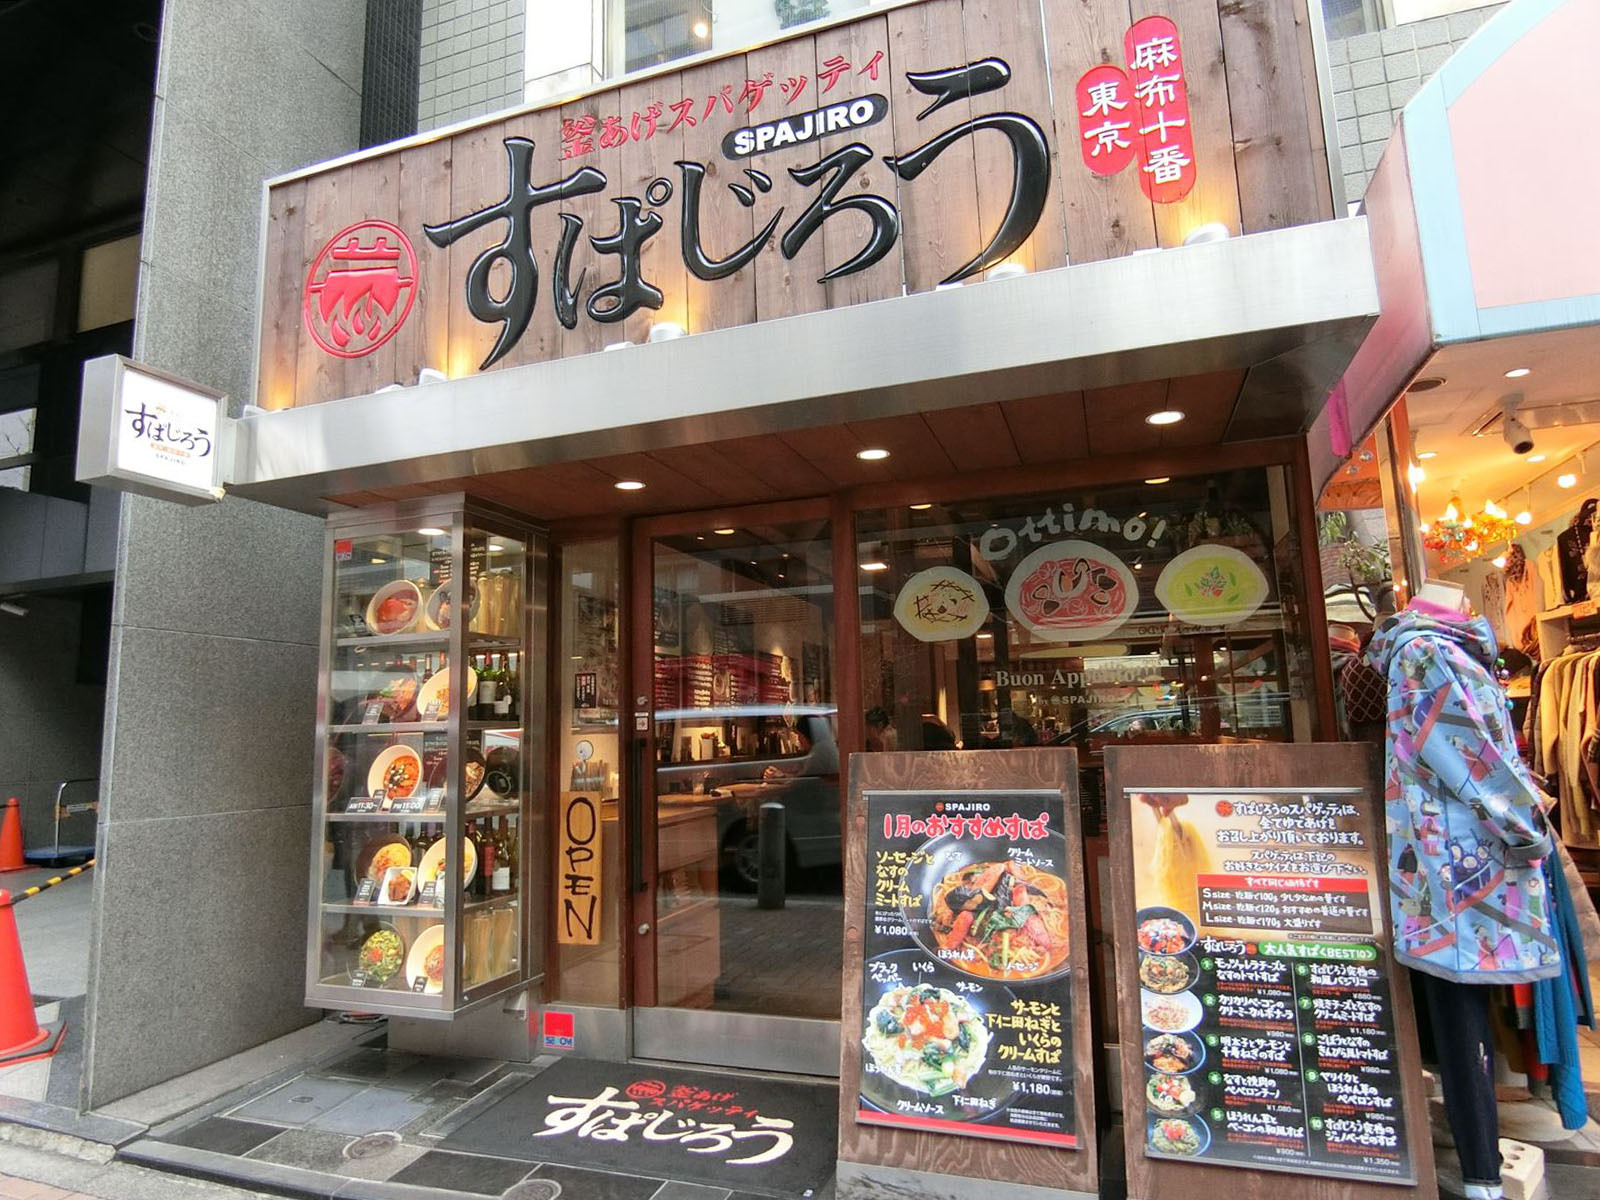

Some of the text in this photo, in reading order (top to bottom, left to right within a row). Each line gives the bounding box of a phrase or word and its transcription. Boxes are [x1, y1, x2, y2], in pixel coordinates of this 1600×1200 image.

[561, 49, 886, 160] 釜あげスパゲッティ
[1129, 36, 1191, 185] 麻布十番
[1082, 80, 1133, 157] 東京
[733, 99, 875, 156] SPAJIRO
[422, 56, 1053, 372] すぱじろう
[124, 402, 211, 457] すぱじろう
[996, 671, 1045, 687] Buon
[945, 803, 991, 811] SPAJIRO
[883, 812, 1050, 840] 1月のおすすめすぱ
[1259, 815, 1337, 830] 全てゆであげを
[1217, 830, 1364, 846] お召し上がり頂いております。
[876, 850, 934, 865] ソーセージと
[1007, 848, 1034, 857] クリーム
[564, 797, 597, 940] OPEN
[876, 865, 909, 878] なすの
[876, 879, 910, 893] クリーム
[875, 893, 923, 908] ミートすぱ
[874, 925, 908, 936] ¥1,080
[868, 961, 898, 973] ブラック
[912, 962, 935, 973] いくら
[871, 973, 903, 982] ペッパー
[955, 981, 984, 992] サーモン
[1010, 999, 1062, 1016] サーモンと
[986, 1013, 1062, 1032] 下仁田ねぎと
[1018, 1032, 1063, 1047] いくらの
[997, 1043, 1063, 1064] クリームすぱ
[1012, 1081, 1051, 1095] ¥1,180
[896, 1099, 944, 1114] クリームソース
[532, 1086, 794, 1165] すぱじろう
